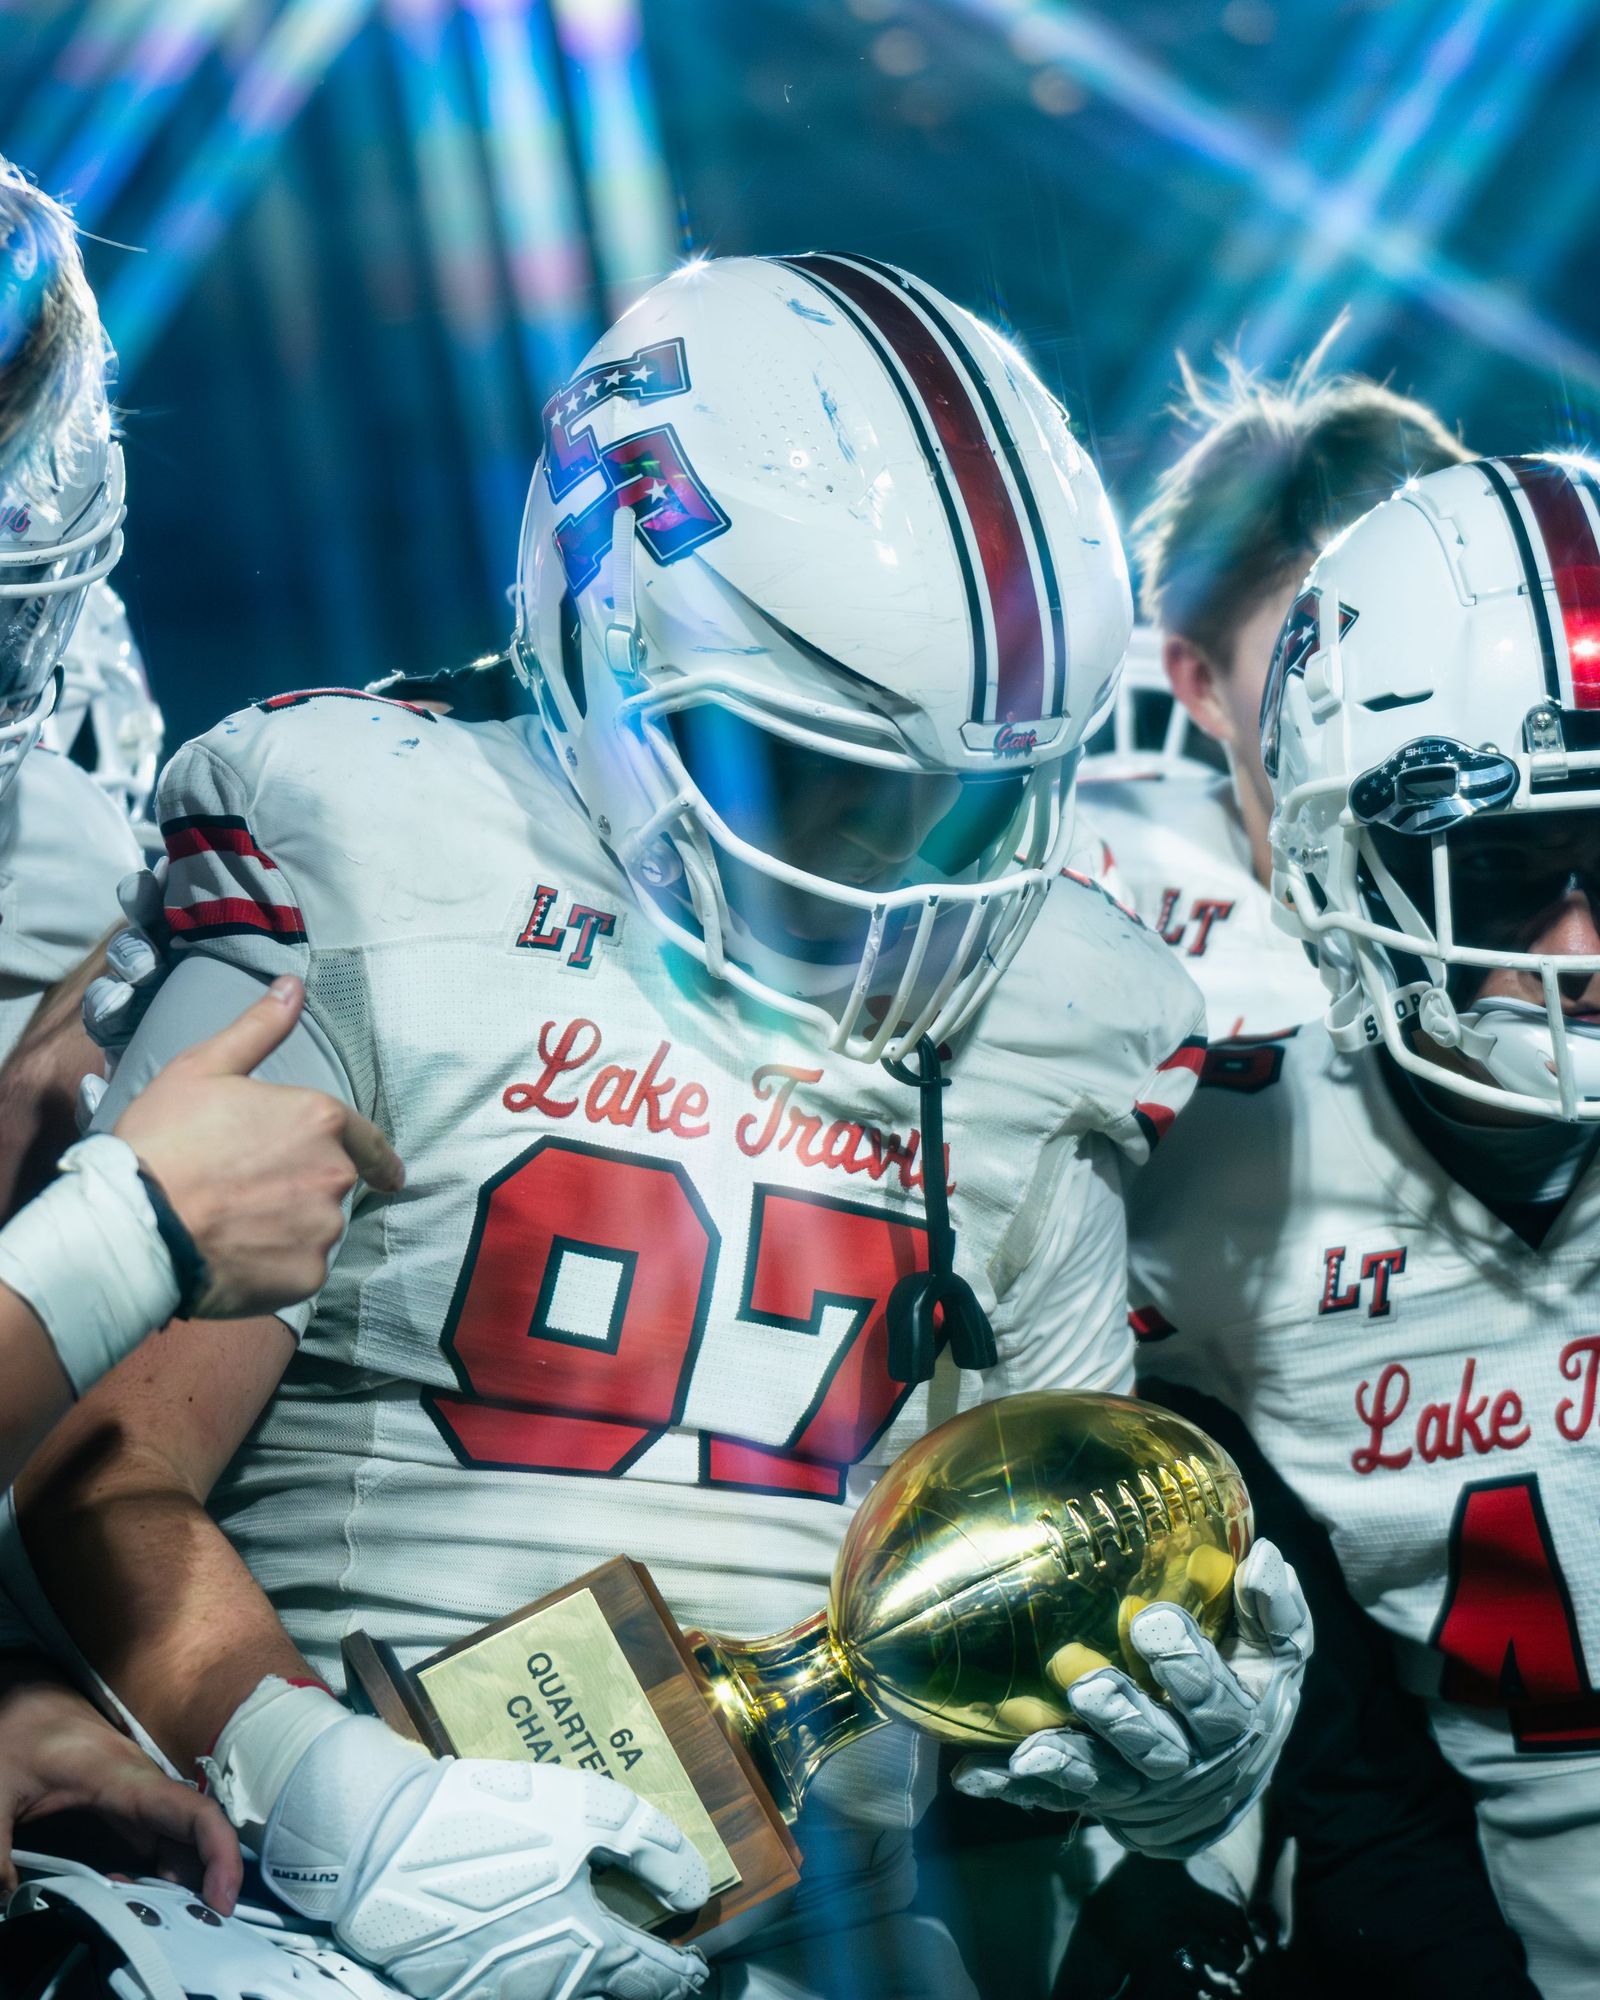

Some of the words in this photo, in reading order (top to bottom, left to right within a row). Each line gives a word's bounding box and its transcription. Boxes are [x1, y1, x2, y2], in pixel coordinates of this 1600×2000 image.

[1404, 744, 1448, 758] SHOCK
[515, 884, 617, 969] LT
[1156, 888, 1236, 957] LT
[503, 1018, 710, 1137] Lake
[420, 1135, 956, 1503] 97
[1318, 1246, 1408, 1319] LT
[1351, 1357, 1532, 1474] Lake
[1555, 1335, 1600, 1442] T
[609, 1728, 644, 1772] 6A
[272, 1868, 339, 1883] CUTTERS
